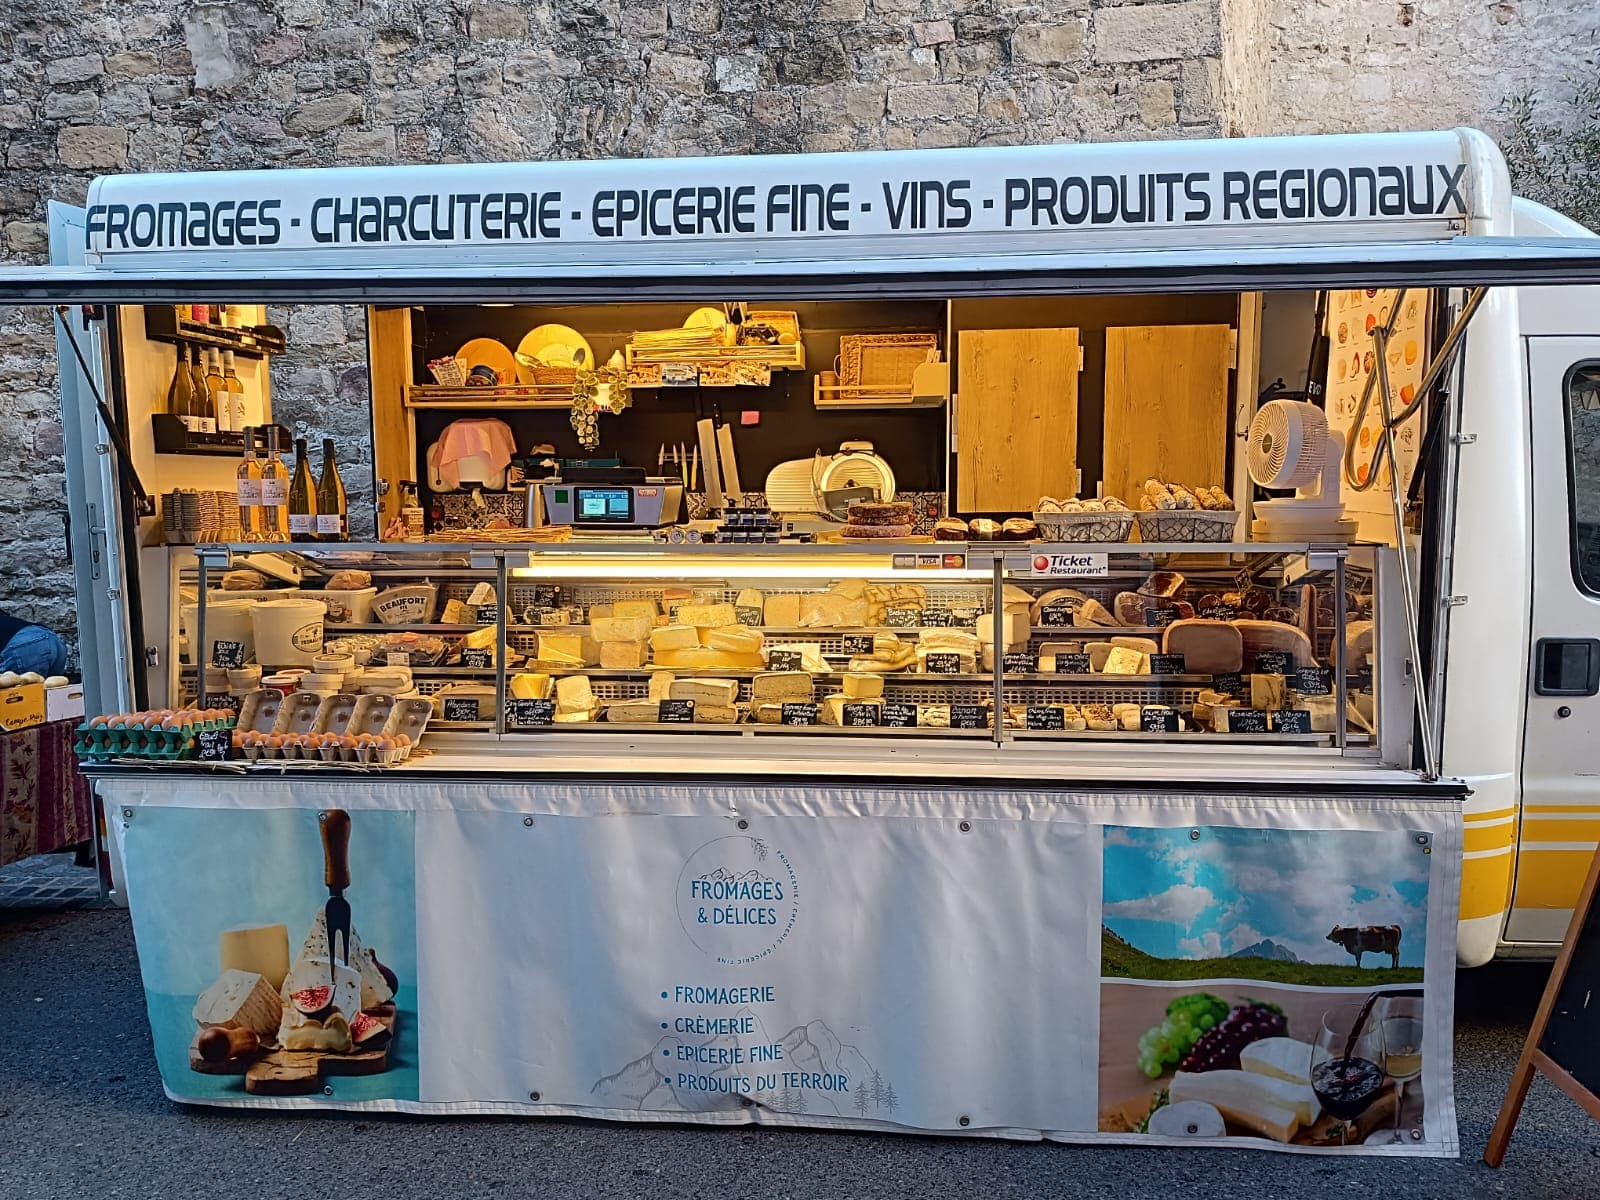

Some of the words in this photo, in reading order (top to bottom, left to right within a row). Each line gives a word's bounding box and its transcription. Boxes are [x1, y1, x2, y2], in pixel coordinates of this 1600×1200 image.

[85, 199, 281, 250] FROMAGES
[310, 191, 562, 243] CHARCUTERIE
[591, 185, 756, 237] EPICERIE
[766, 183, 850, 233] FINE
[882, 179, 972, 230] VINS
[1005, 172, 1212, 227] PRODUITS
[1223, 164, 1468, 221] REGIONAUX
[1051, 555, 1093, 567] Ticket
[380, 597, 426, 612] BEAUFORT
[691, 880, 784, 901] FROMAGES
[697, 906, 709, 924] &
[713, 904, 777, 925] DÉLICES
[675, 985, 775, 1005] FROMAGERIE
[676, 1045, 745, 1065] EPICERIE
[749, 1044, 784, 1063] FINE
[677, 1073, 751, 1094] PRODUITS
[756, 1074, 776, 1092] DU
[781, 1072, 849, 1093] TERROIR
